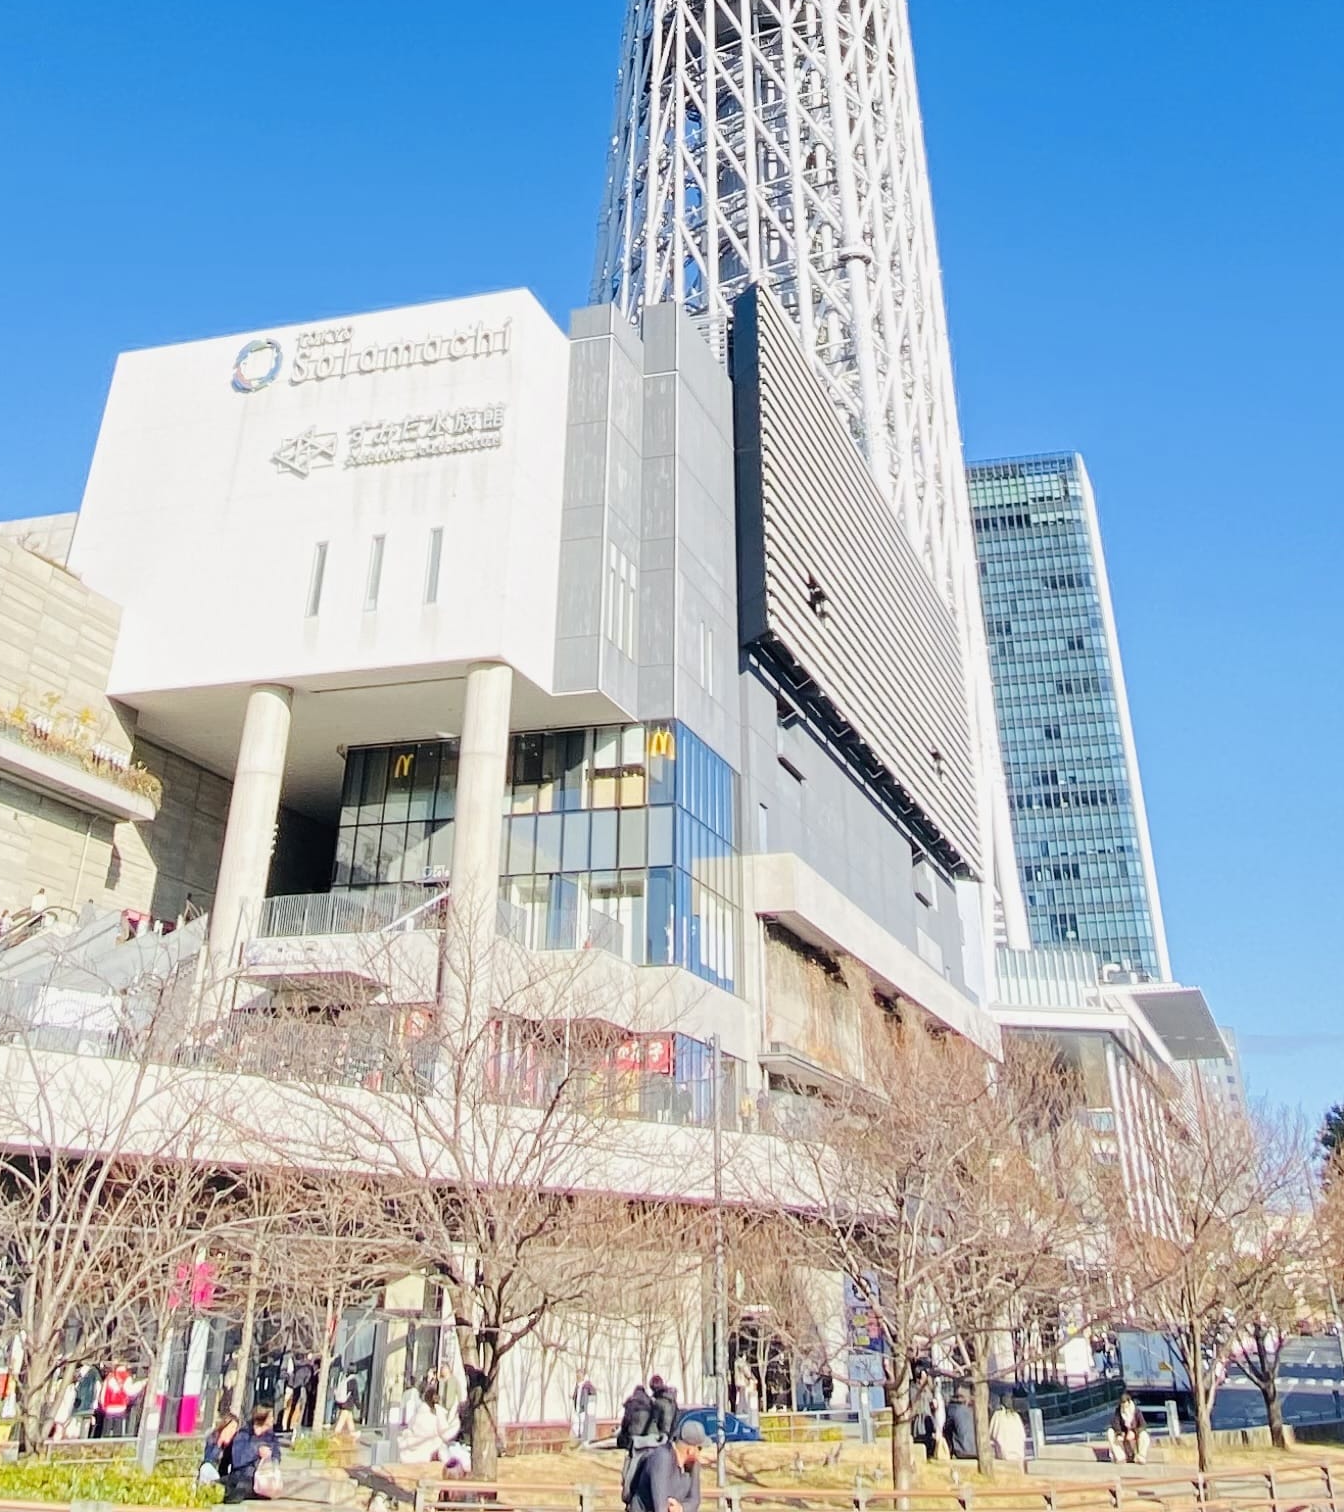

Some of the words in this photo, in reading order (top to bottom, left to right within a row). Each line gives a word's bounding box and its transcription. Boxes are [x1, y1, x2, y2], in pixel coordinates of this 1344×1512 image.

[288, 317, 512, 386] Solamachi
[347, 403, 506, 454] すみだ水族館
